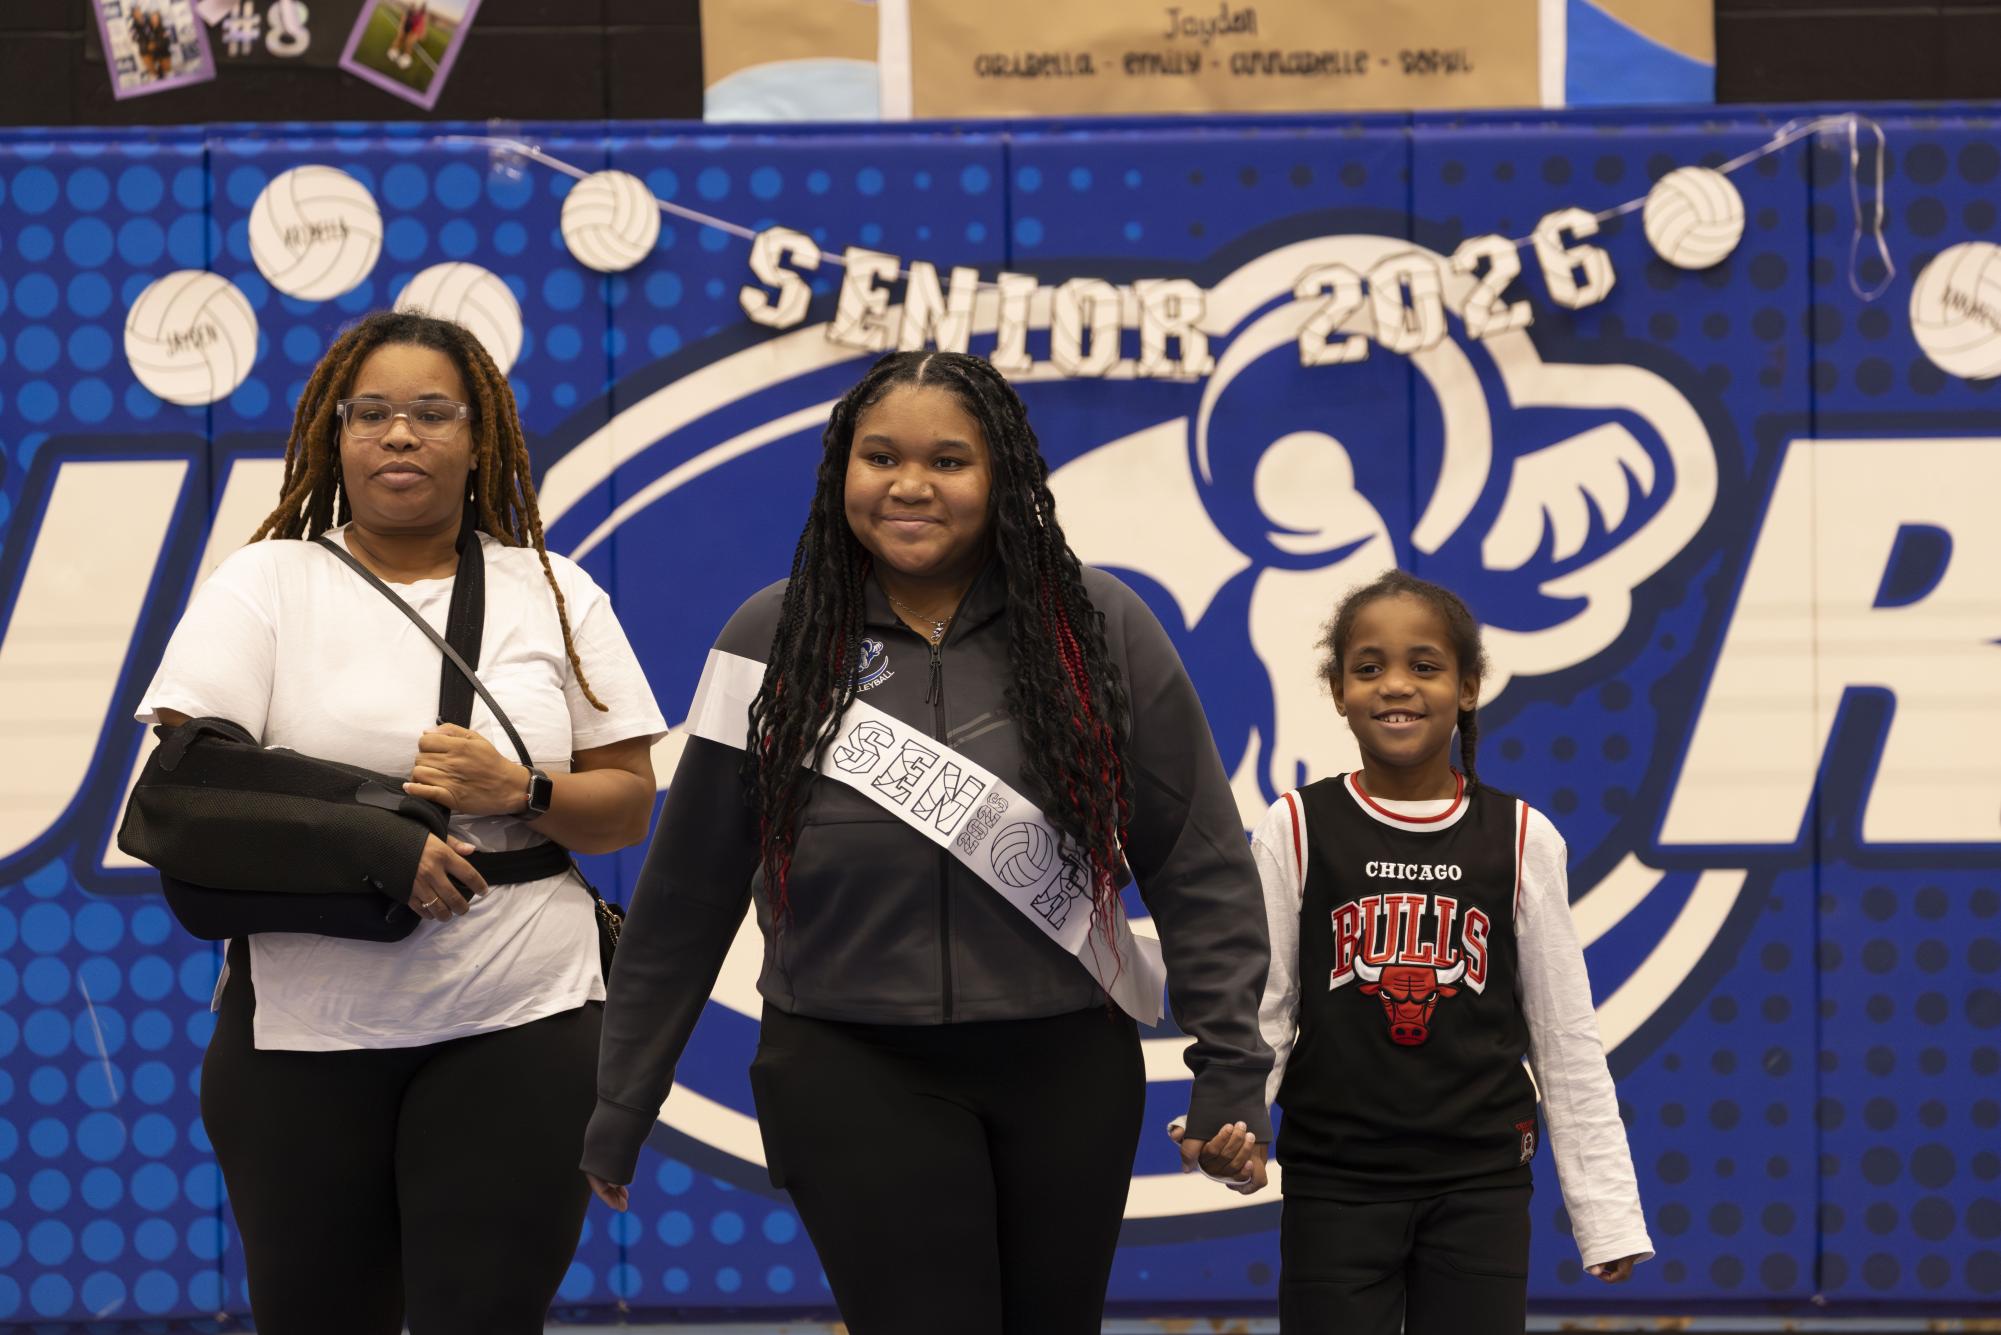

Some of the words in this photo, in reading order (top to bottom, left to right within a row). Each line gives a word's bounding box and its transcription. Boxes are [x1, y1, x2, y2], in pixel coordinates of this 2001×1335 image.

[738, 225, 1216, 378] SENIOR
[1294, 206, 1618, 367] 2026
[955, 791, 1010, 857] 2026
[1364, 860, 1463, 882] CHICAGO
[1328, 891, 1491, 997] BULLS
